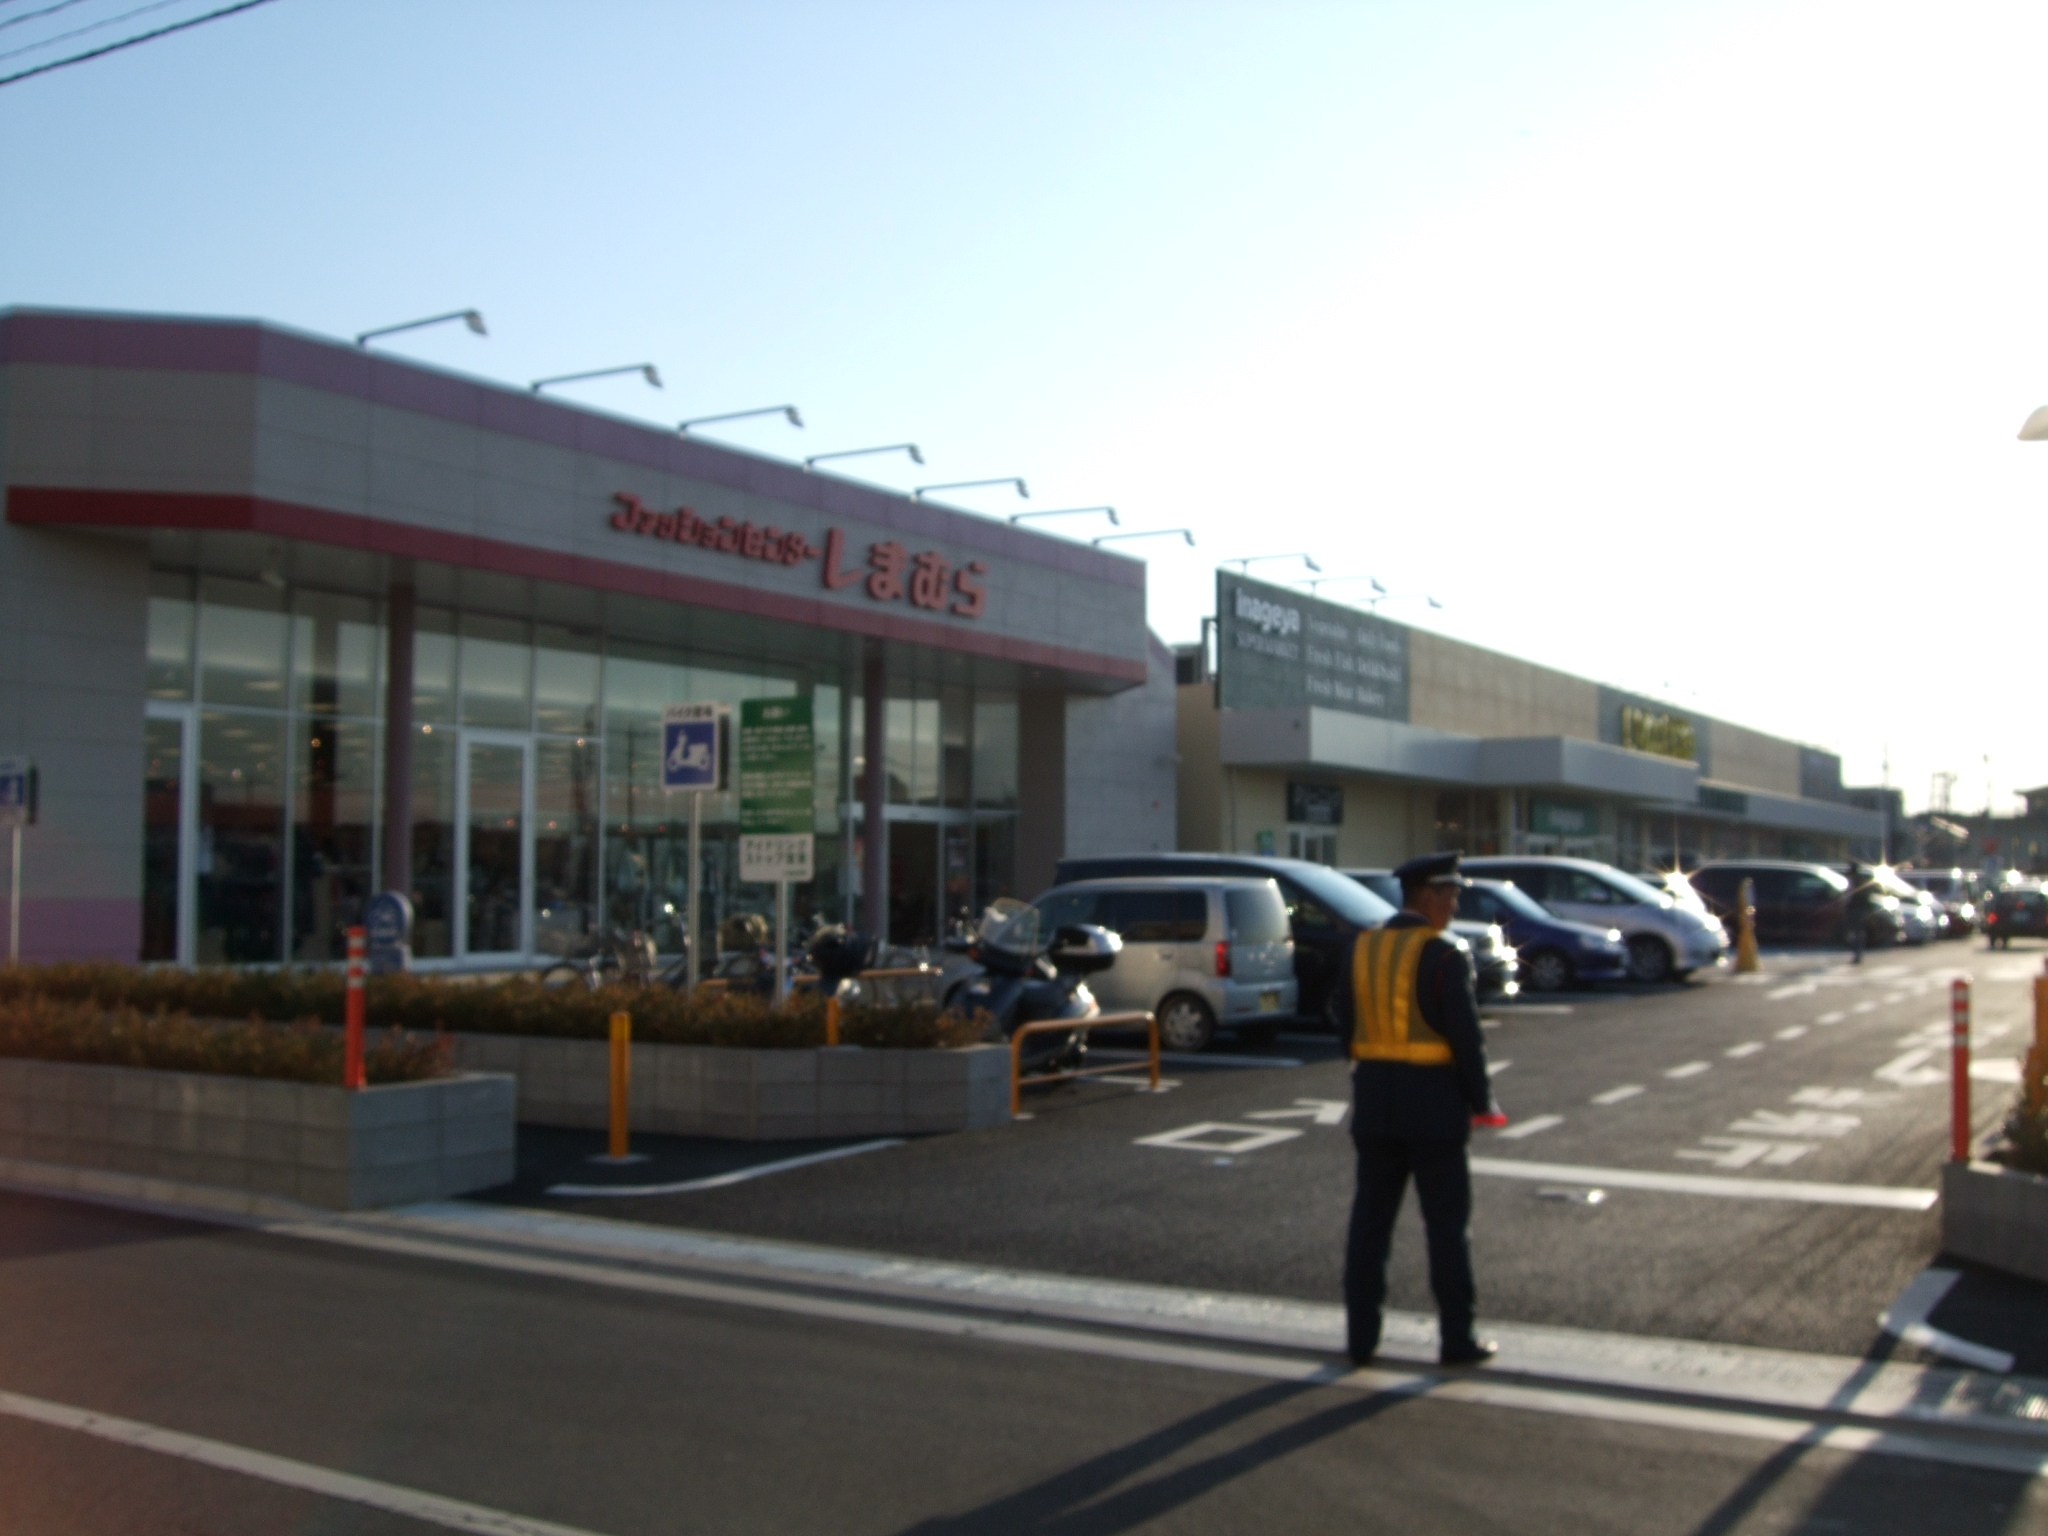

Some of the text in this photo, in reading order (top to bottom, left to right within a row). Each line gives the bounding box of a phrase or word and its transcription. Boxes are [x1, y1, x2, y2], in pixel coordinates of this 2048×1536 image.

[611, 491, 990, 617] ファッションセンター しまむら
